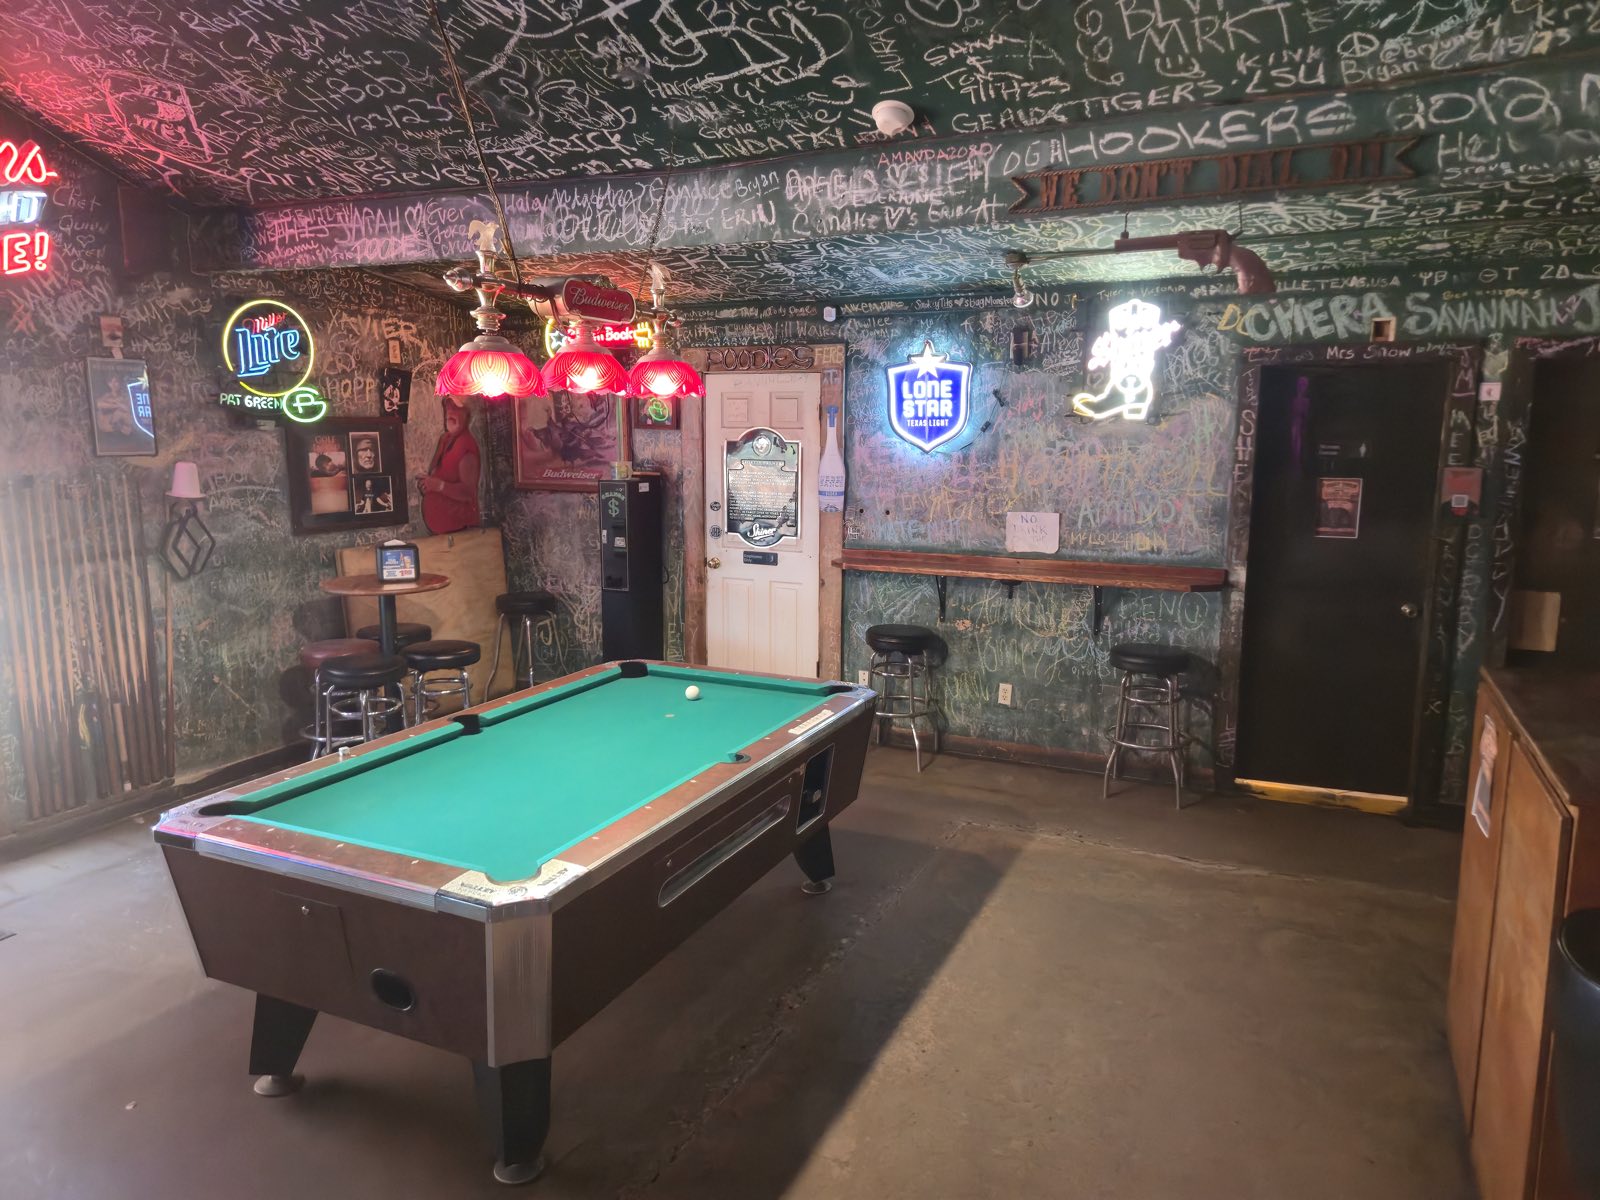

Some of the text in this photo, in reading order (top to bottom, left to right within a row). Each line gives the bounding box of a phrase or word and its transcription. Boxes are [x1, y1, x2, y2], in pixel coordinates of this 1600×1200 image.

[1246, 62, 1325, 94] LSU
[1341, 59, 1418, 85] Bryan
[1062, 94, 1355, 166] HOOKERS
[570, 286, 630, 312] Budweiser
[242, 312, 288, 334] Miller
[235, 327, 301, 377] Lite
[220, 392, 241, 406] PAT
[902, 399, 953, 418] STAR
[906, 418, 949, 427] TEXAS LIGHT
[542, 468, 600, 480] Budweiser
[747, 523, 778, 539] Shiner
